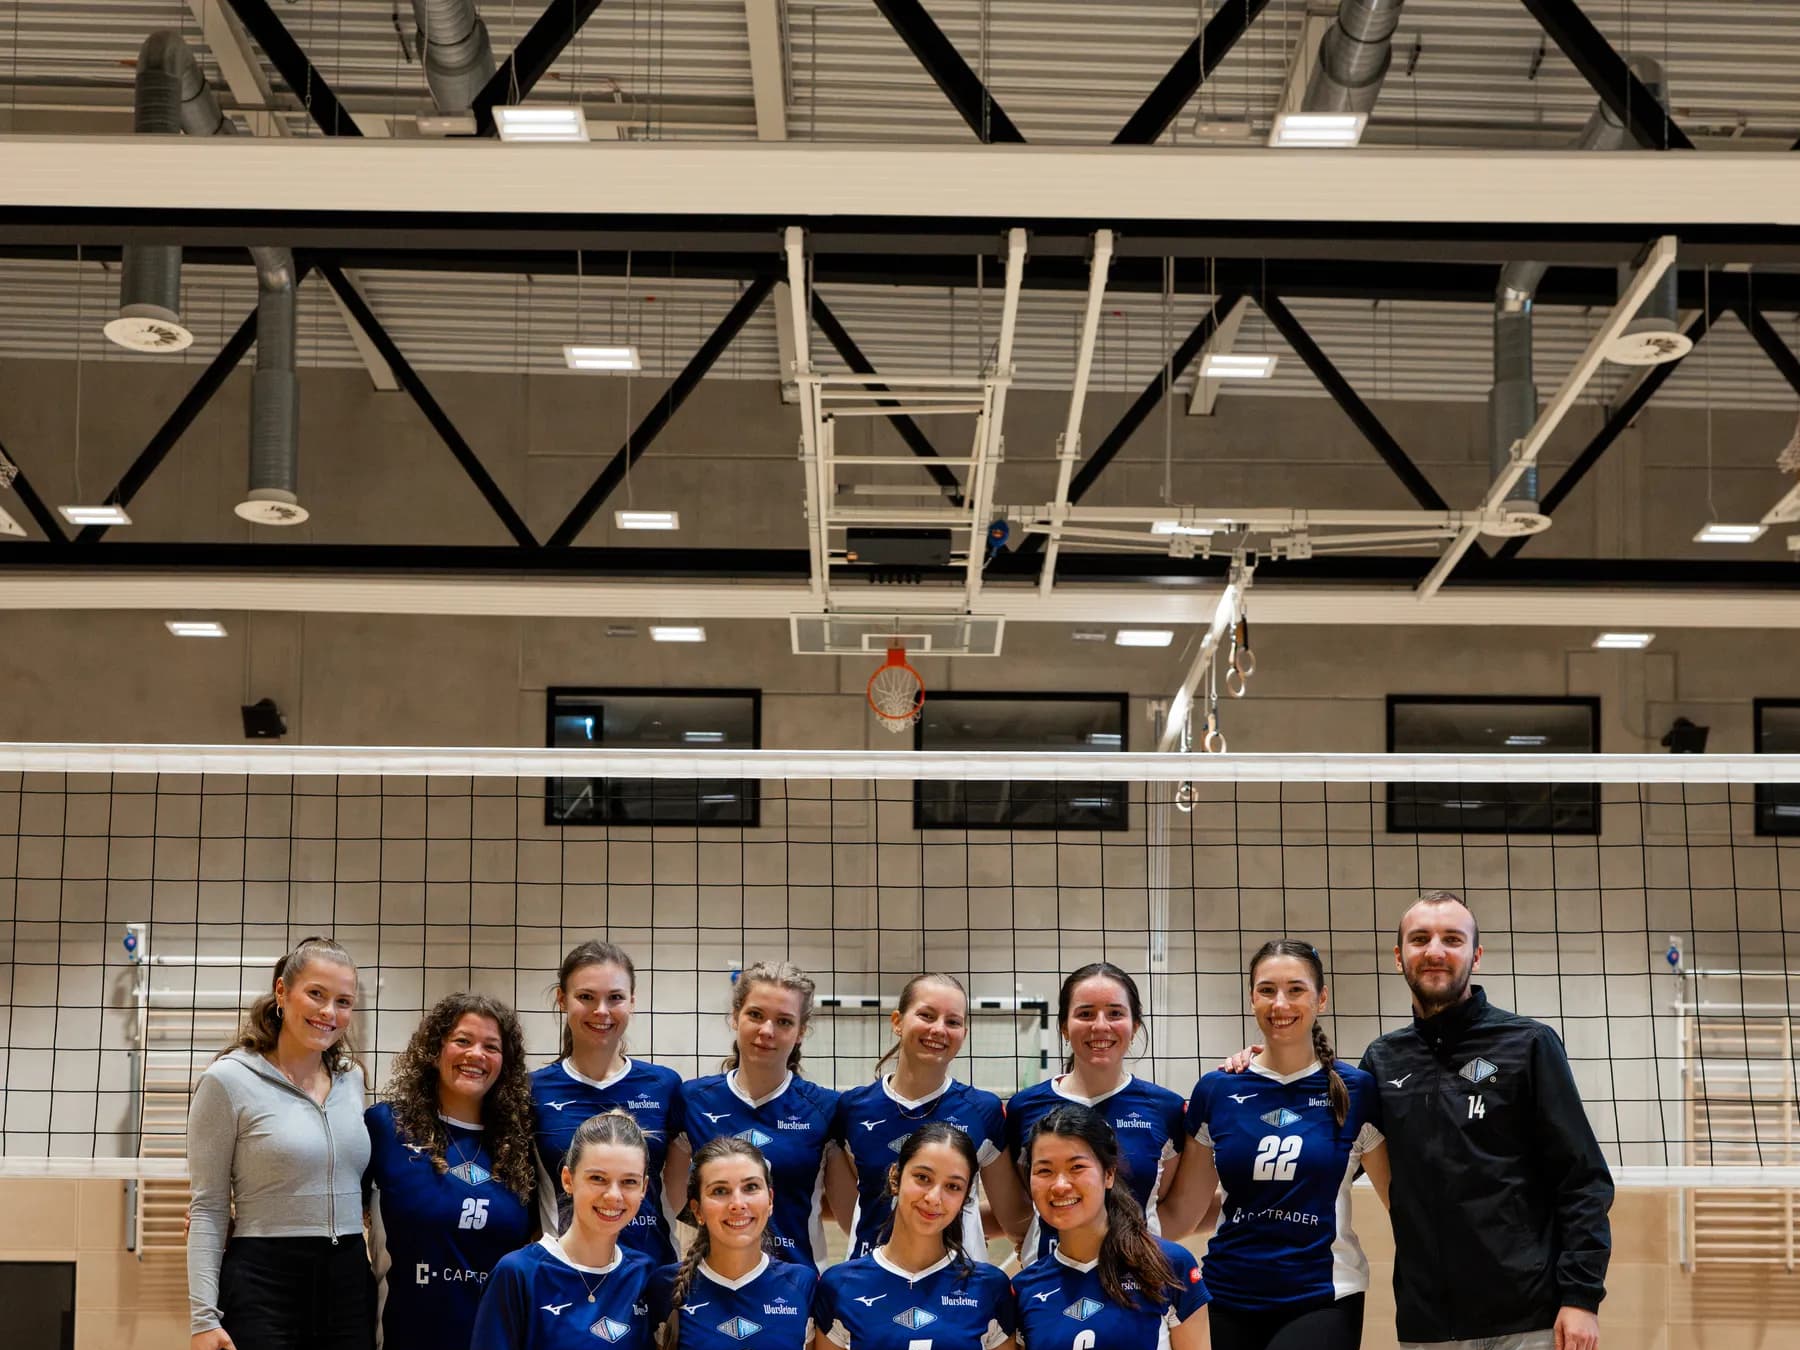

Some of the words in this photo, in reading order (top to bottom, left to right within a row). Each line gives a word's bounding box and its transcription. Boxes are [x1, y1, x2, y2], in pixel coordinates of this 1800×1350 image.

[1467, 1094, 1486, 1119] 14
[1116, 1118, 1152, 1129] Warsteiner
[1252, 1134, 1304, 1181] 22
[458, 1197, 490, 1230] 25
[763, 1303, 798, 1315] Warsteiner
[941, 1295, 979, 1308] Warsteiner
